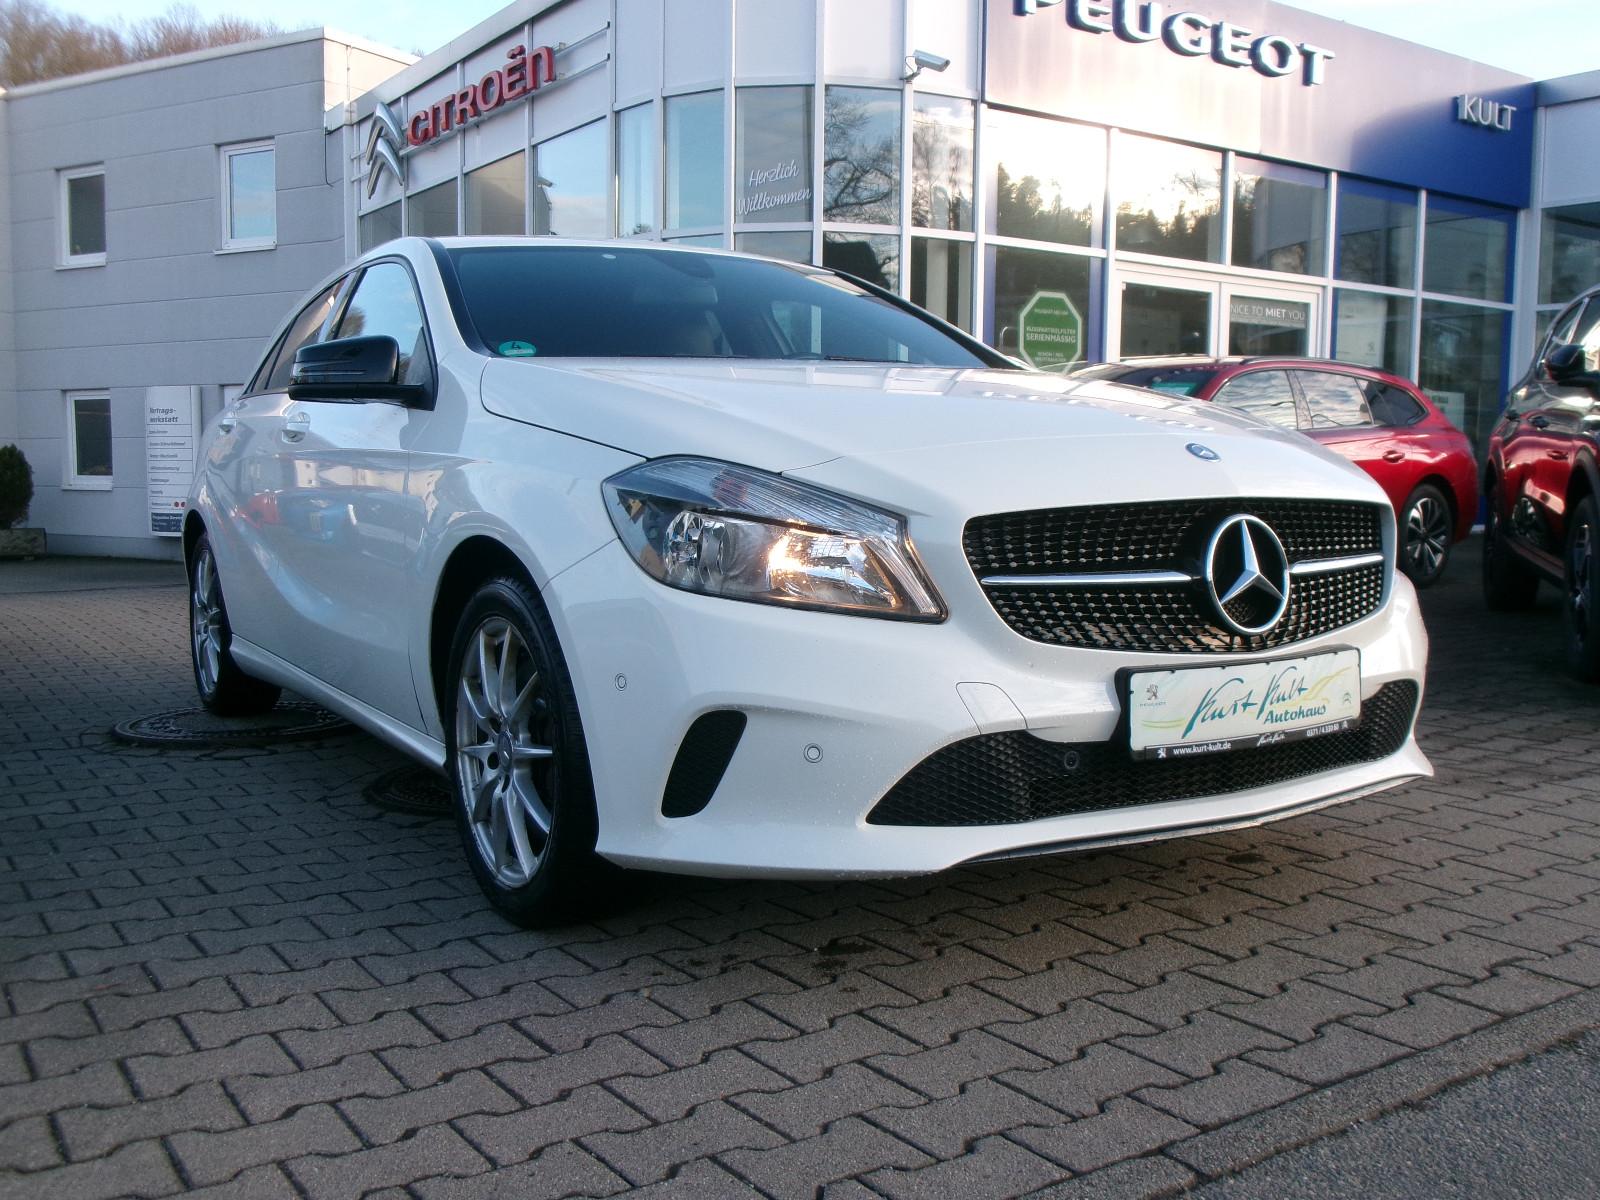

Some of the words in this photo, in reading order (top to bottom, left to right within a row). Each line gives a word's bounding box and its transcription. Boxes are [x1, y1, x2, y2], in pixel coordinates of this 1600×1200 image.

[1458, 94, 1517, 130] KULT
[749, 160, 799, 186] Herzlich
[738, 187, 811, 215] Willkommen
[1231, 303, 1248, 315] NICE
[1251, 305, 1264, 316] TO
[1265, 307, 1286, 320] MIET
[1288, 310, 1305, 321] YOU
[1181, 677, 1257, 739] Kurt
[1256, 666, 1308, 720] Kult
[1263, 704, 1326, 724] Autohaus
[1173, 741, 1232, 755] www.kurt-kult.de
